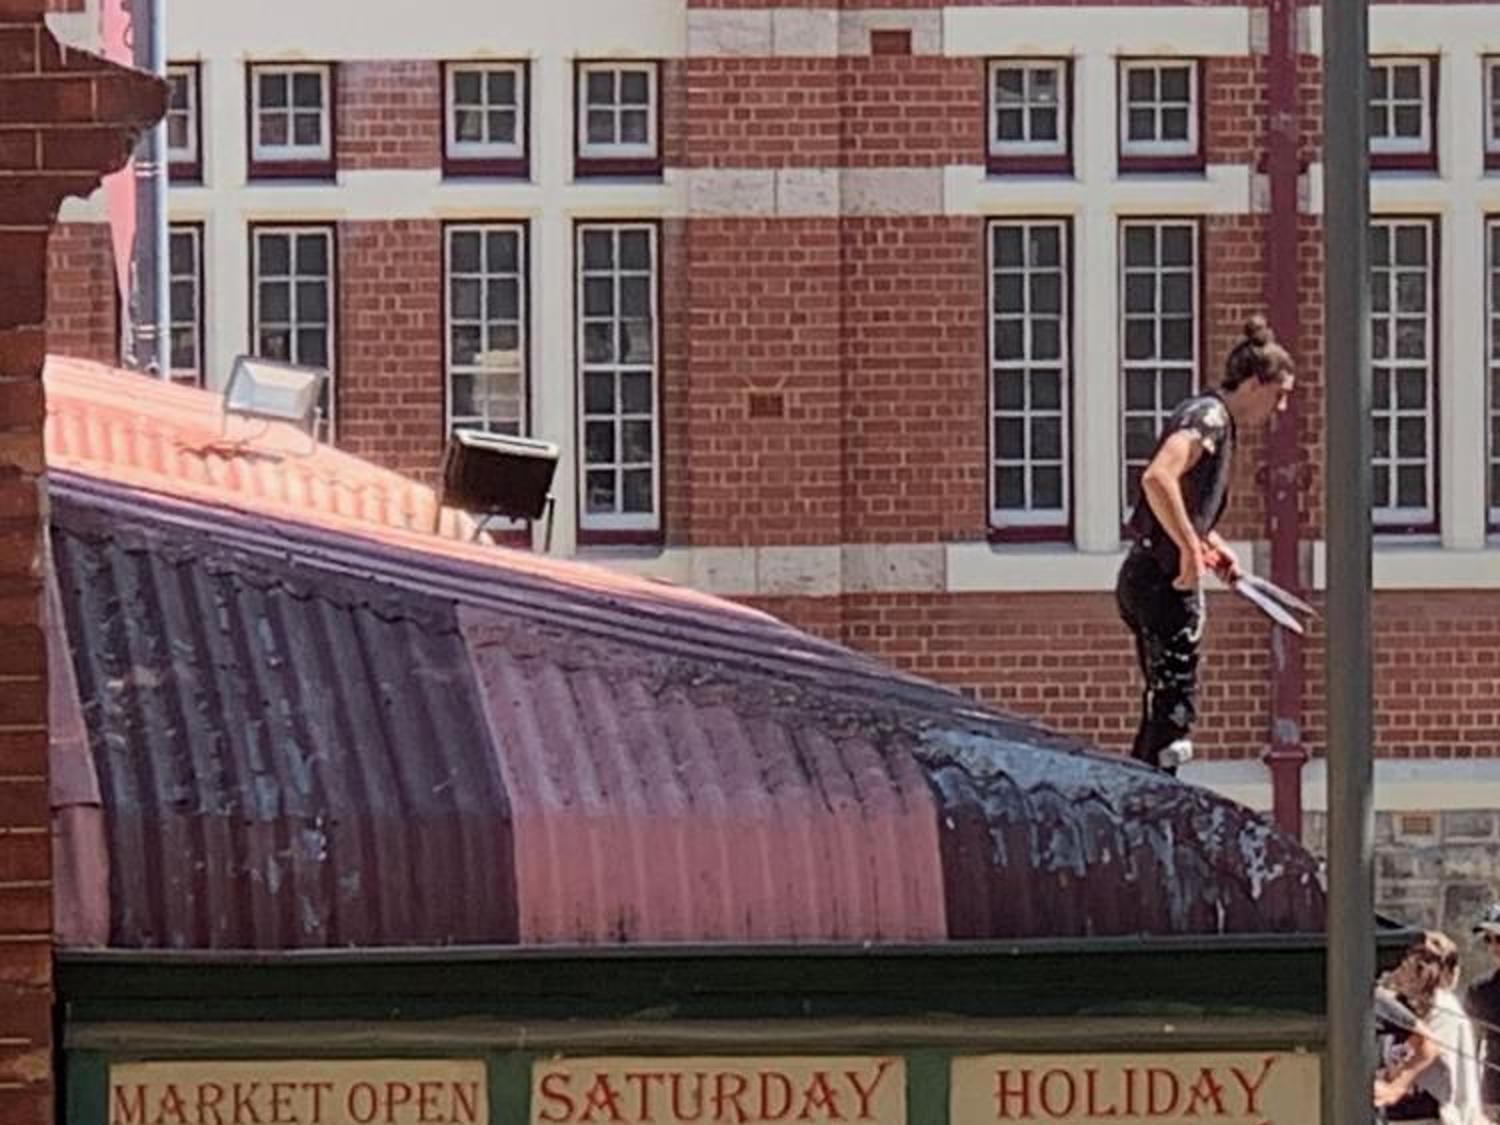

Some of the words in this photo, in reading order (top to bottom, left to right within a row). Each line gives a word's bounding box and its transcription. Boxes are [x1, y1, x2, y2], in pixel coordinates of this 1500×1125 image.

[347, 1080, 481, 1125] OPEN
[538, 1058, 896, 1124] SATURDAY
[996, 1055, 1280, 1120] HOLIDAY
